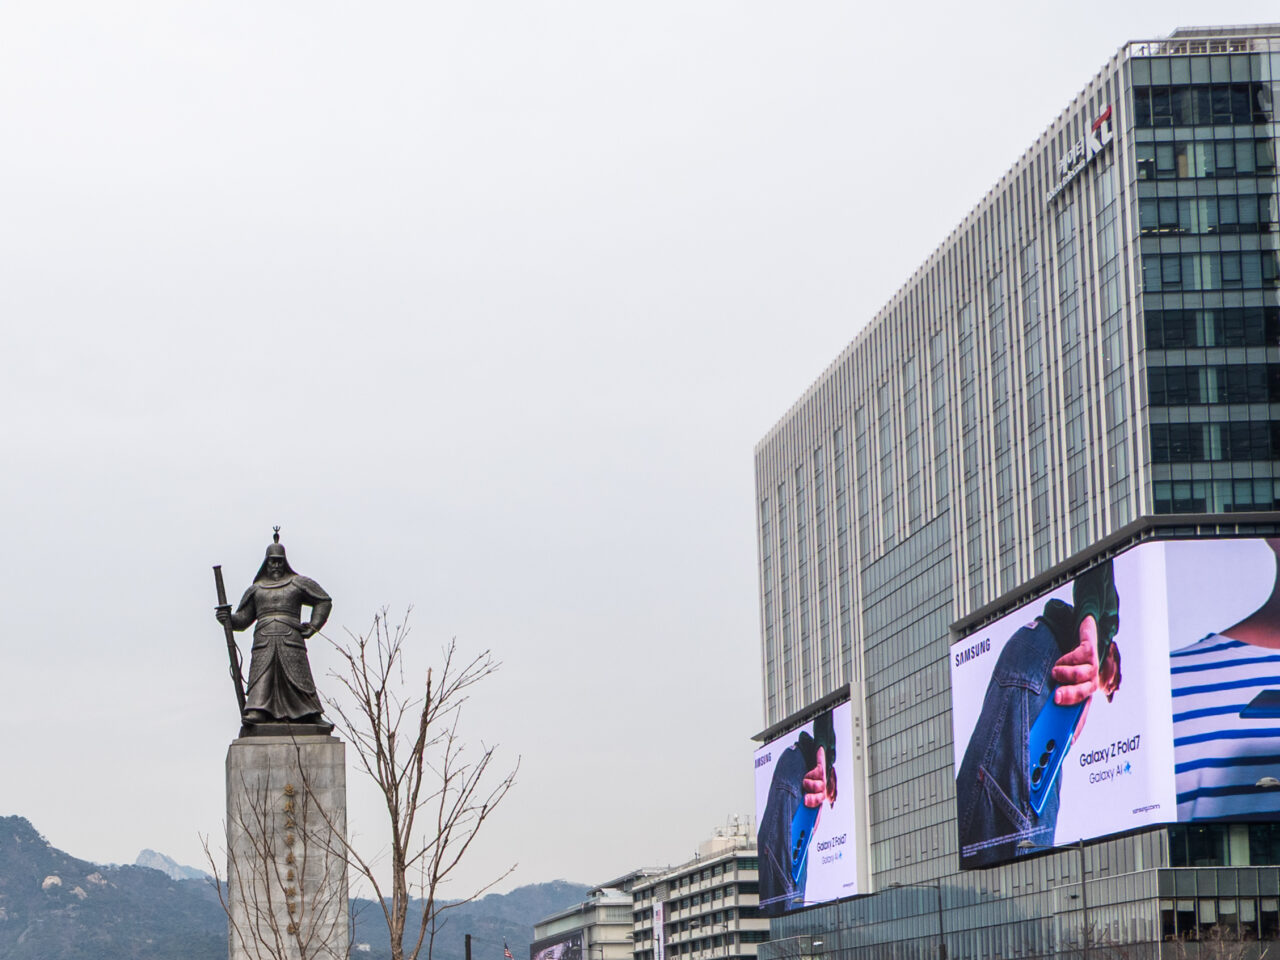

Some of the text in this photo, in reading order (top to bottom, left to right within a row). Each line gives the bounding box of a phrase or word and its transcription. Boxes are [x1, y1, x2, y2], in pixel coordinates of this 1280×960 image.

[955, 638, 991, 668] SAMSUNG
[1079, 747, 1111, 768] Galaxy
[1117, 735, 1141, 756] Fold7
[1089, 766, 1115, 784] Galaxy
